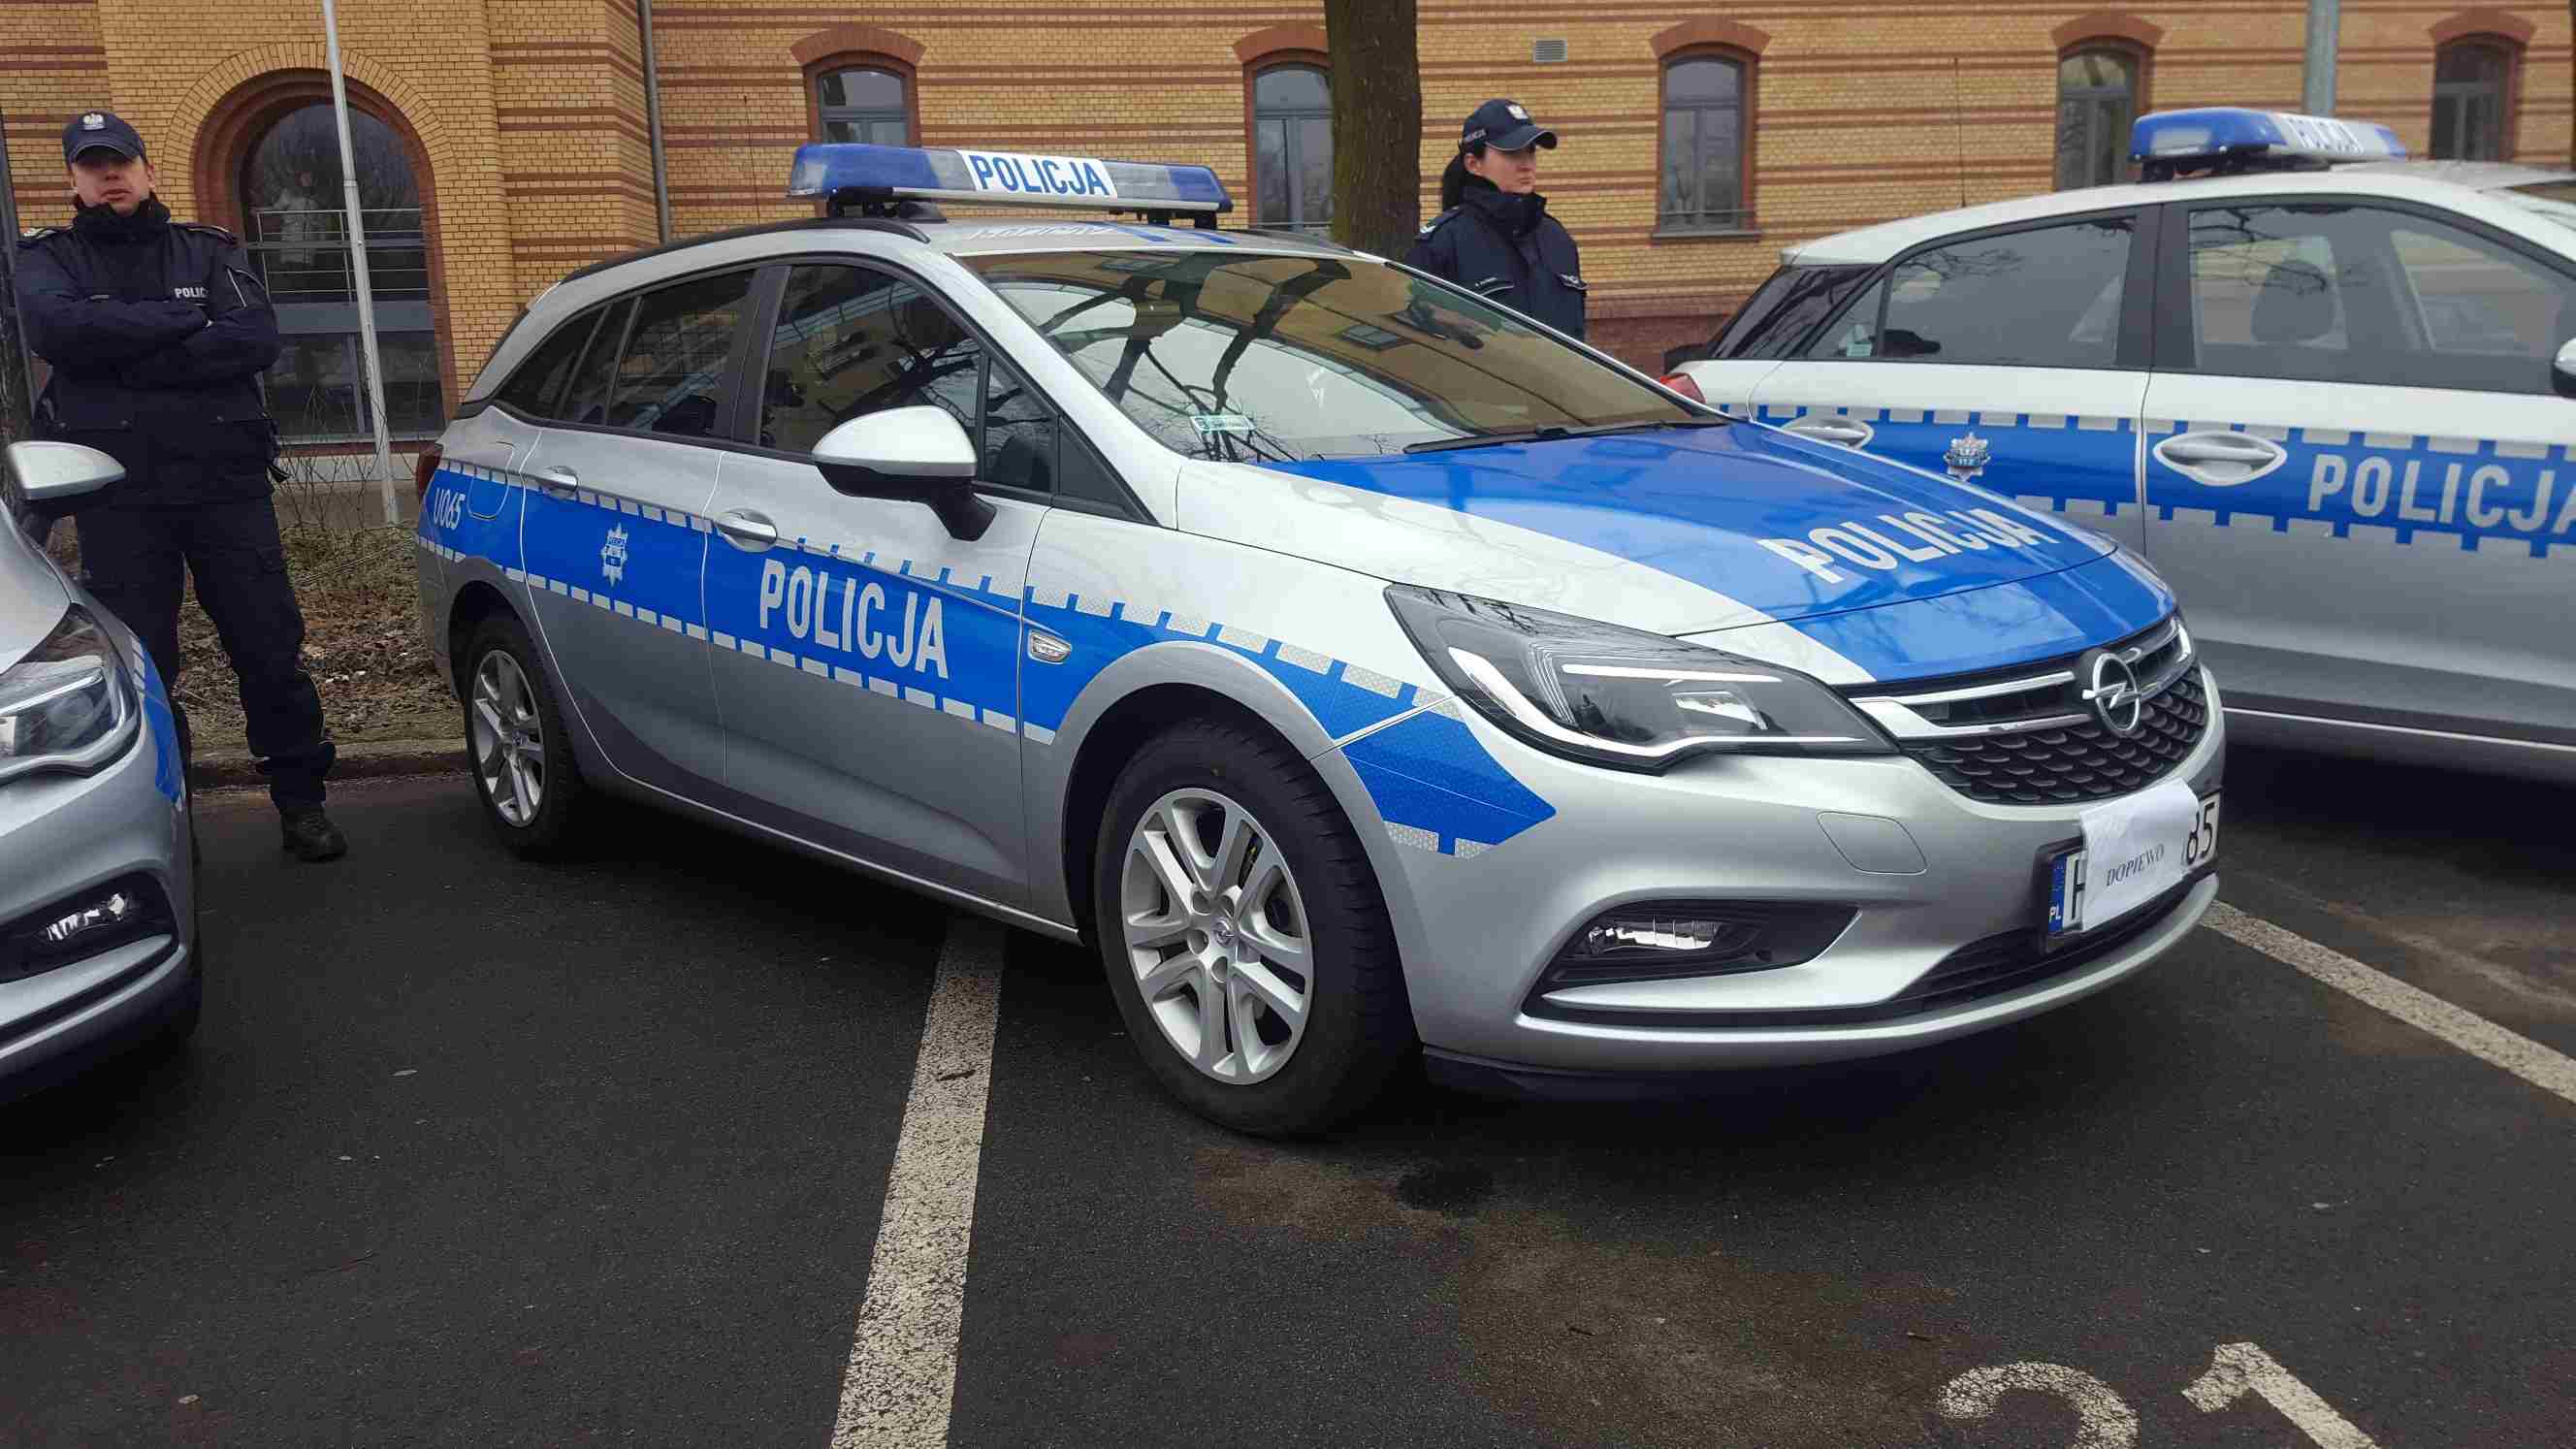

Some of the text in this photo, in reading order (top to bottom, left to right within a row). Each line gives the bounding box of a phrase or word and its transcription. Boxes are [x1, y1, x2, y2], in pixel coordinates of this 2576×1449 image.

[969, 154, 1111, 196] POLICJA
[434, 488, 466, 531] U065
[1756, 509, 2060, 583] POLICJA
[760, 558, 949, 679] POLICJA
[2106, 843, 2165, 886] DOPIEWO
[2049, 906, 2062, 922] PL
